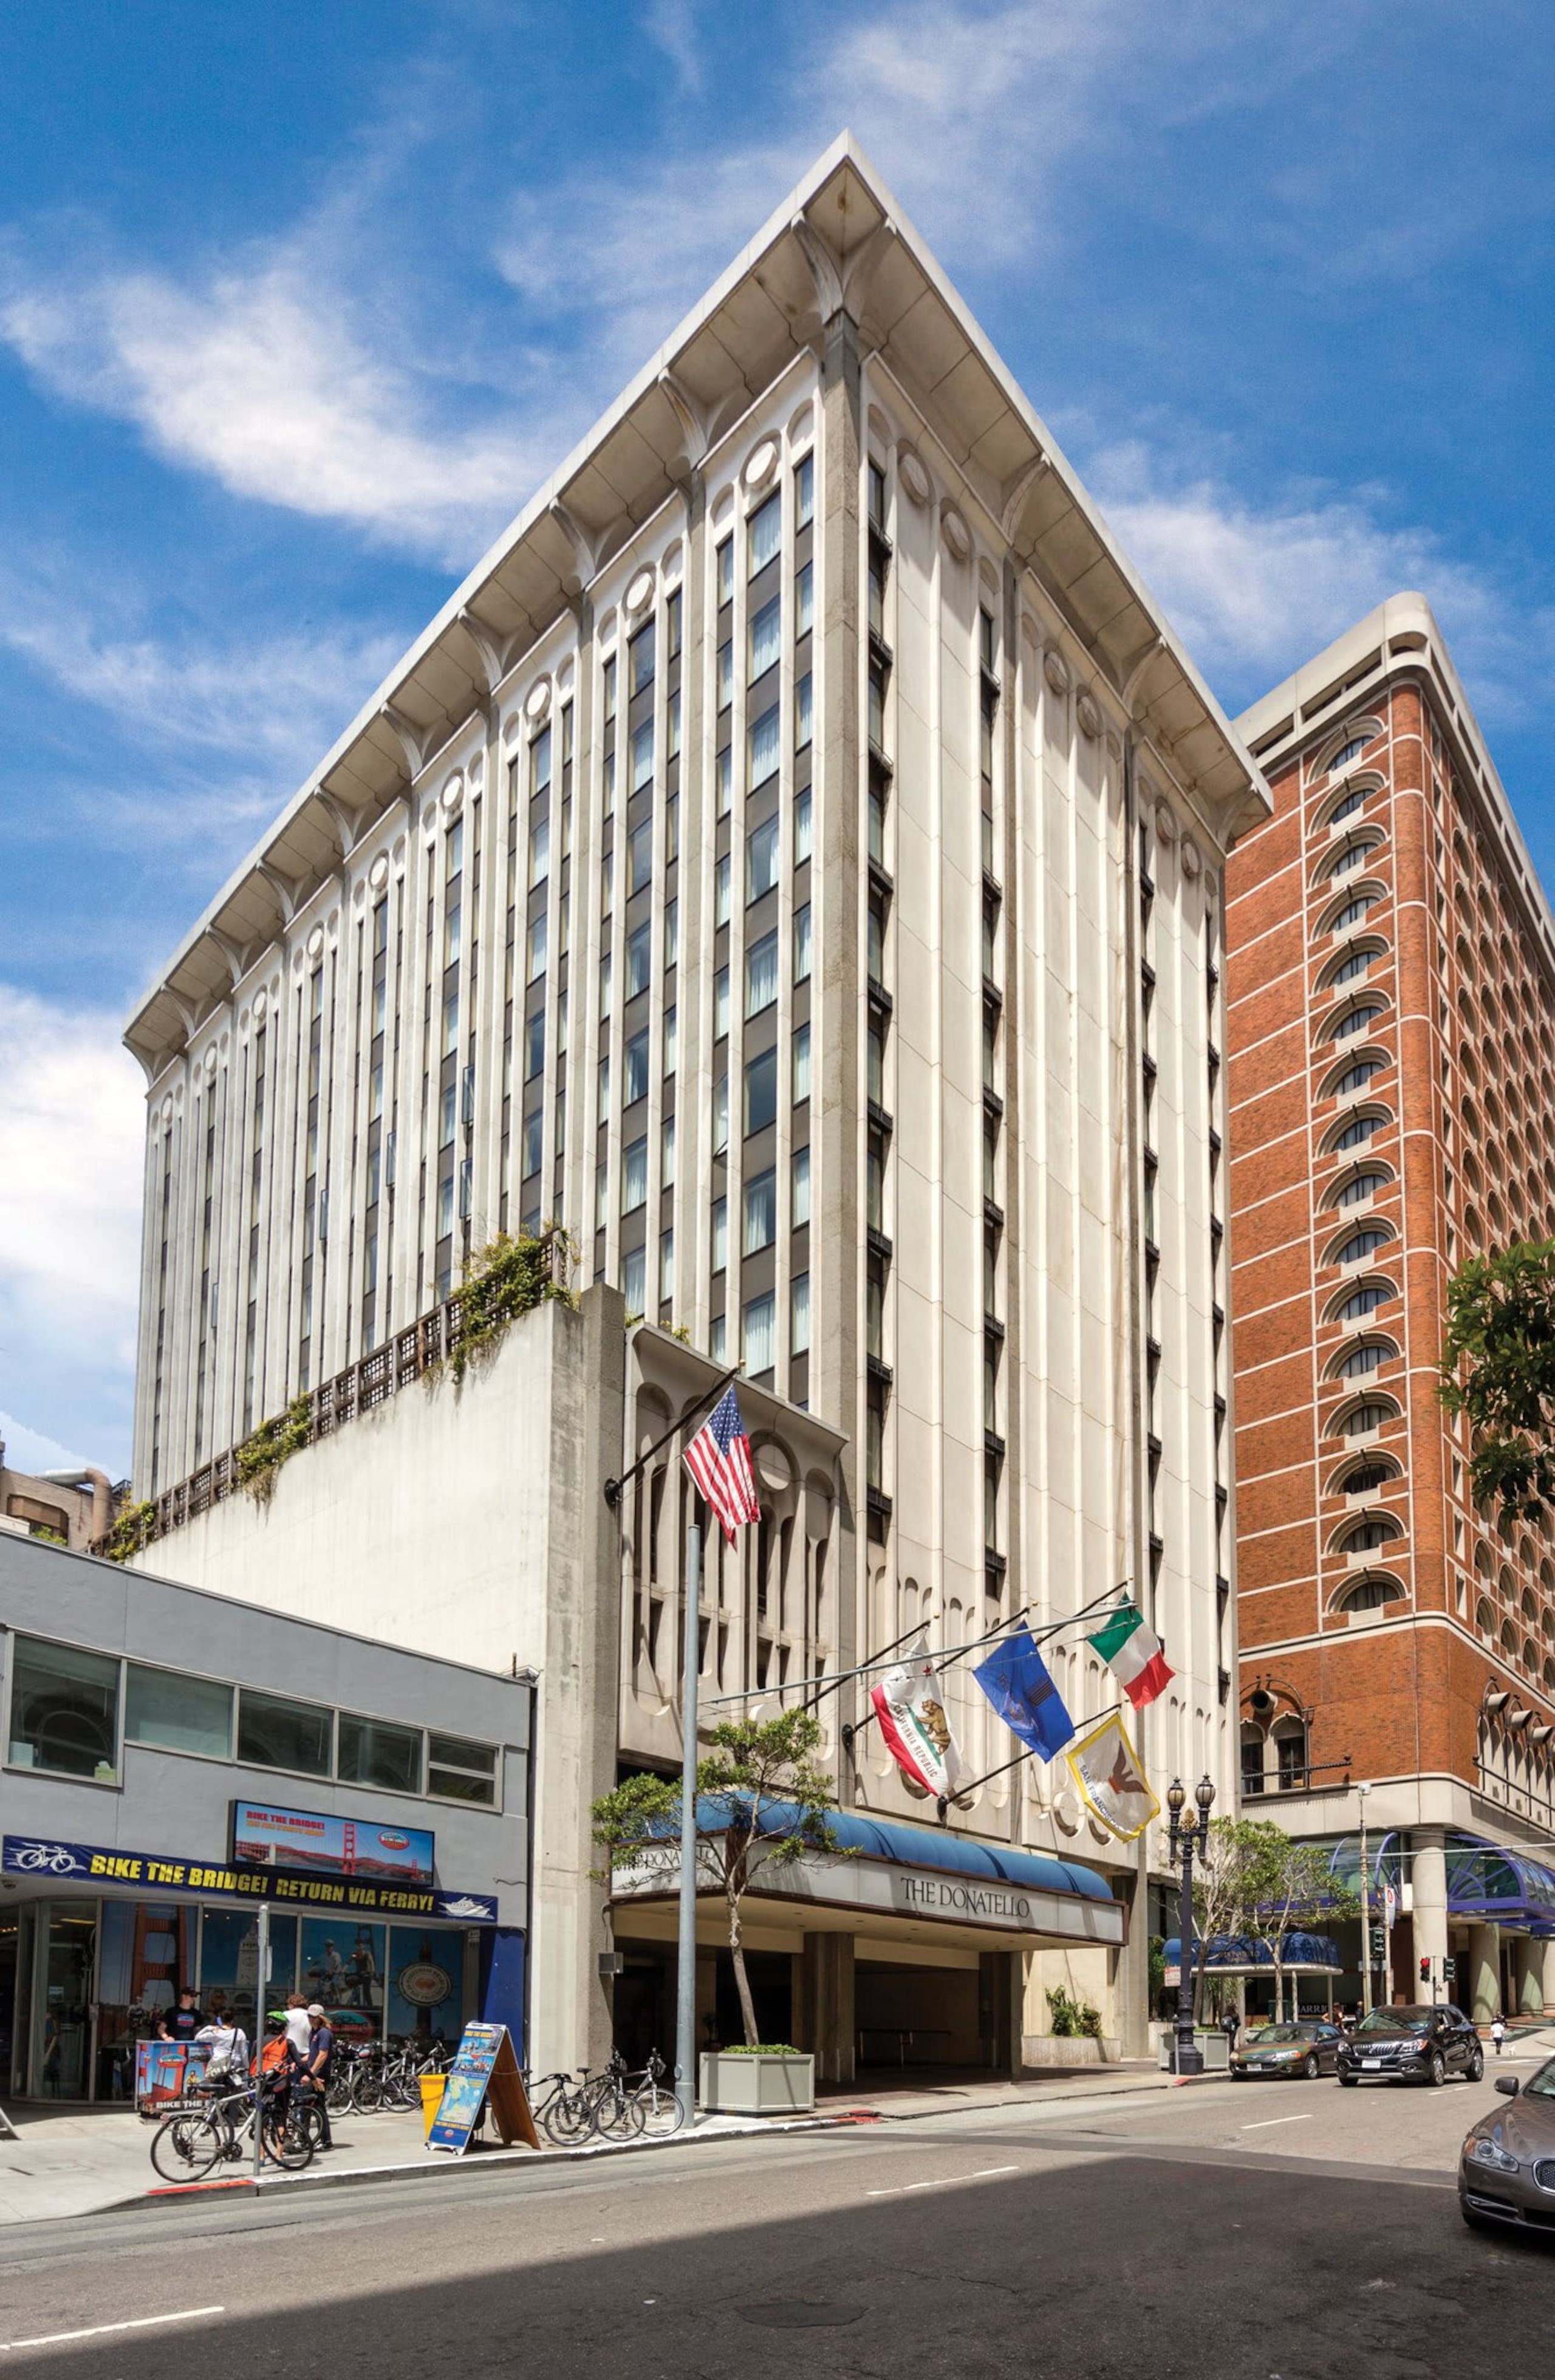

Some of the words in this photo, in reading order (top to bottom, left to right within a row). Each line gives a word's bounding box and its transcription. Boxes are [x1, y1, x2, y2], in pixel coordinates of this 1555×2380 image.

[914, 1745, 938, 1777] REPUBLIC
[1080, 1764, 1092, 1784] SAN
[90, 1855, 143, 1879] BIKE
[147, 1862, 185, 1884] THE
[188, 1867, 269, 1894] BRIDGE!
[275, 1878, 345, 1903] RETURN
[348, 1886, 376, 1906] VIA
[379, 1890, 435, 1912] FERRY!
[901, 1877, 937, 1904] THE
[939, 1884, 1030, 1918] DONATELLO
[156, 2101, 181, 2109] BIKE
[183, 2100, 203, 2109] THE
